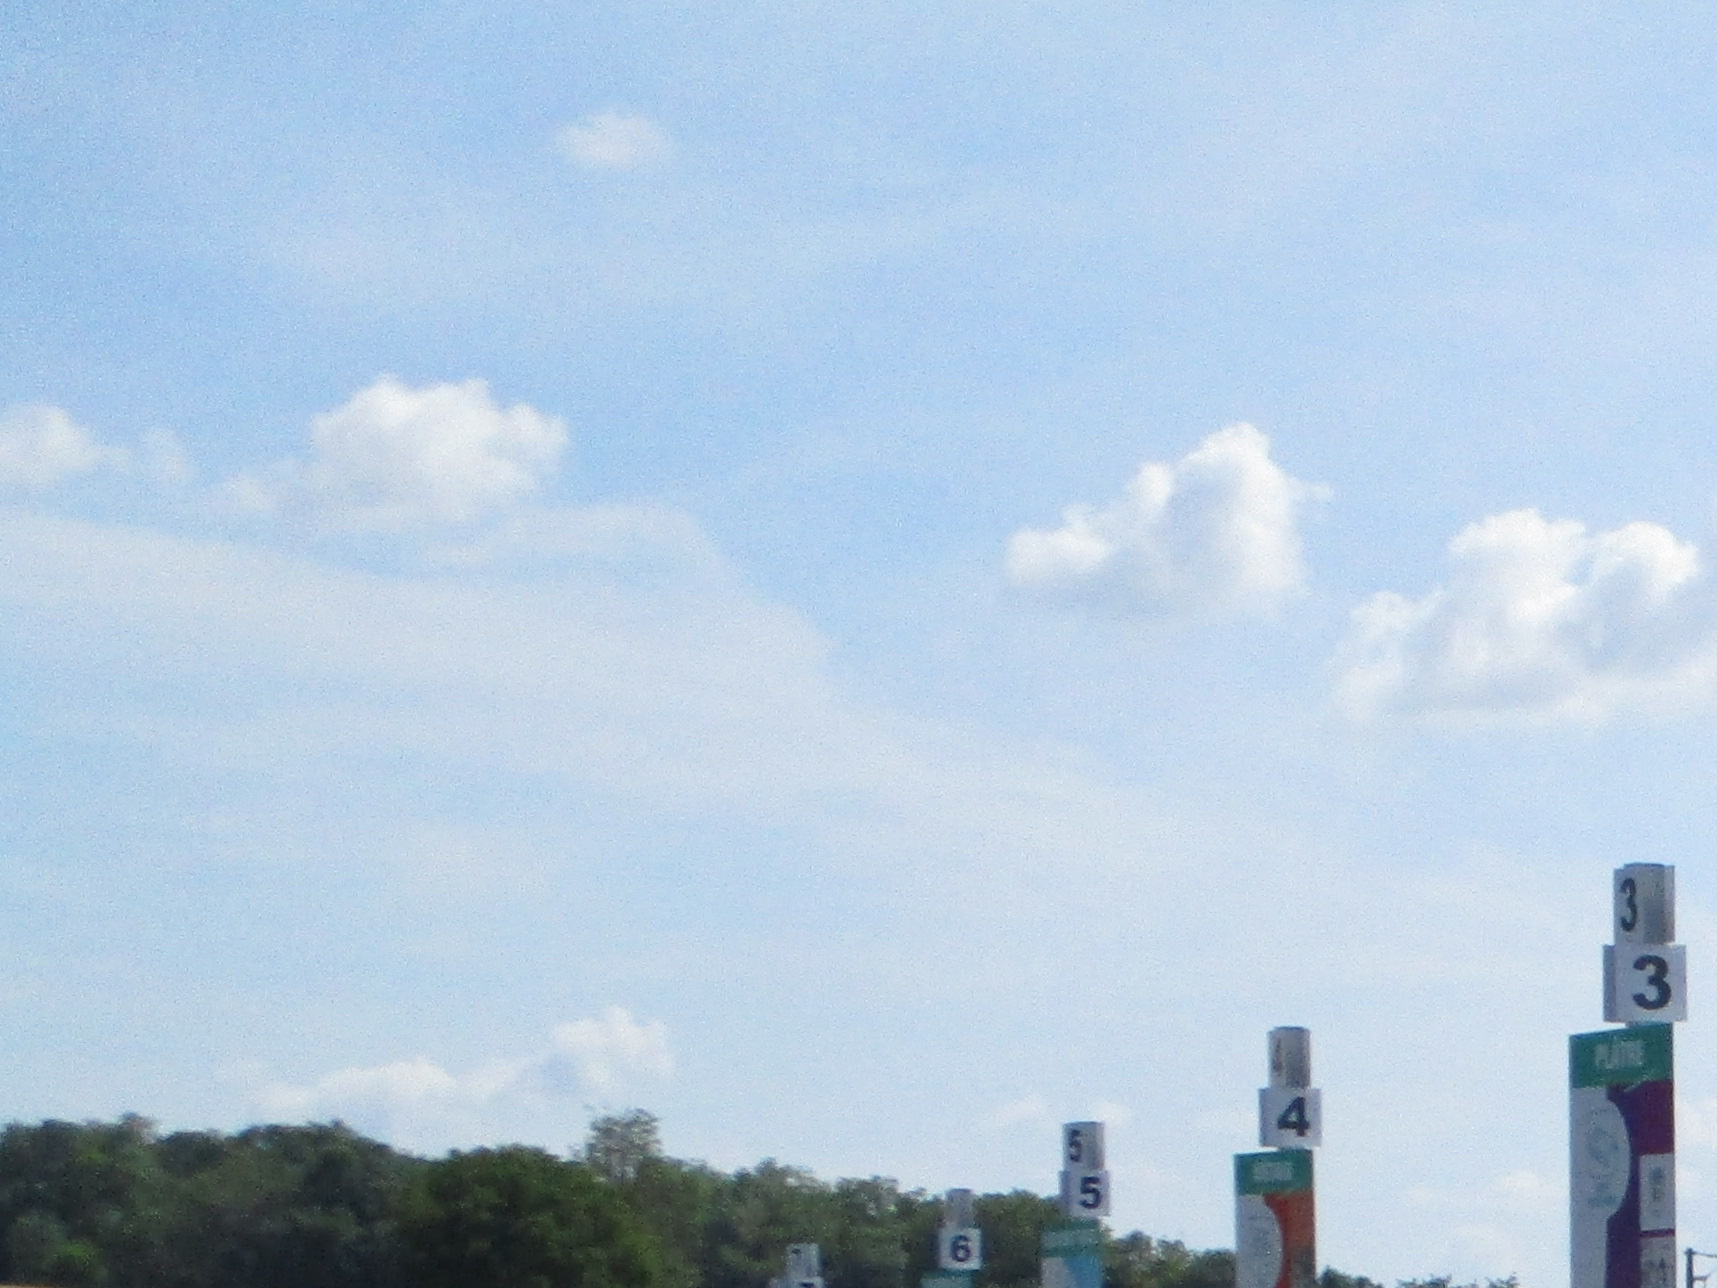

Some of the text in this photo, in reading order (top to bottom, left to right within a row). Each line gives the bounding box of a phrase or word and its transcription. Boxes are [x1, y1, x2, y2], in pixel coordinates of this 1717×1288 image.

[1619, 877, 1638, 932] 3
[1632, 954, 1672, 1011] 3
[1277, 1096, 1310, 1138] 4
[1068, 1129, 1082, 1163] 5
[1079, 1176, 1101, 1209] 5
[952, 1234, 972, 1262] 6
